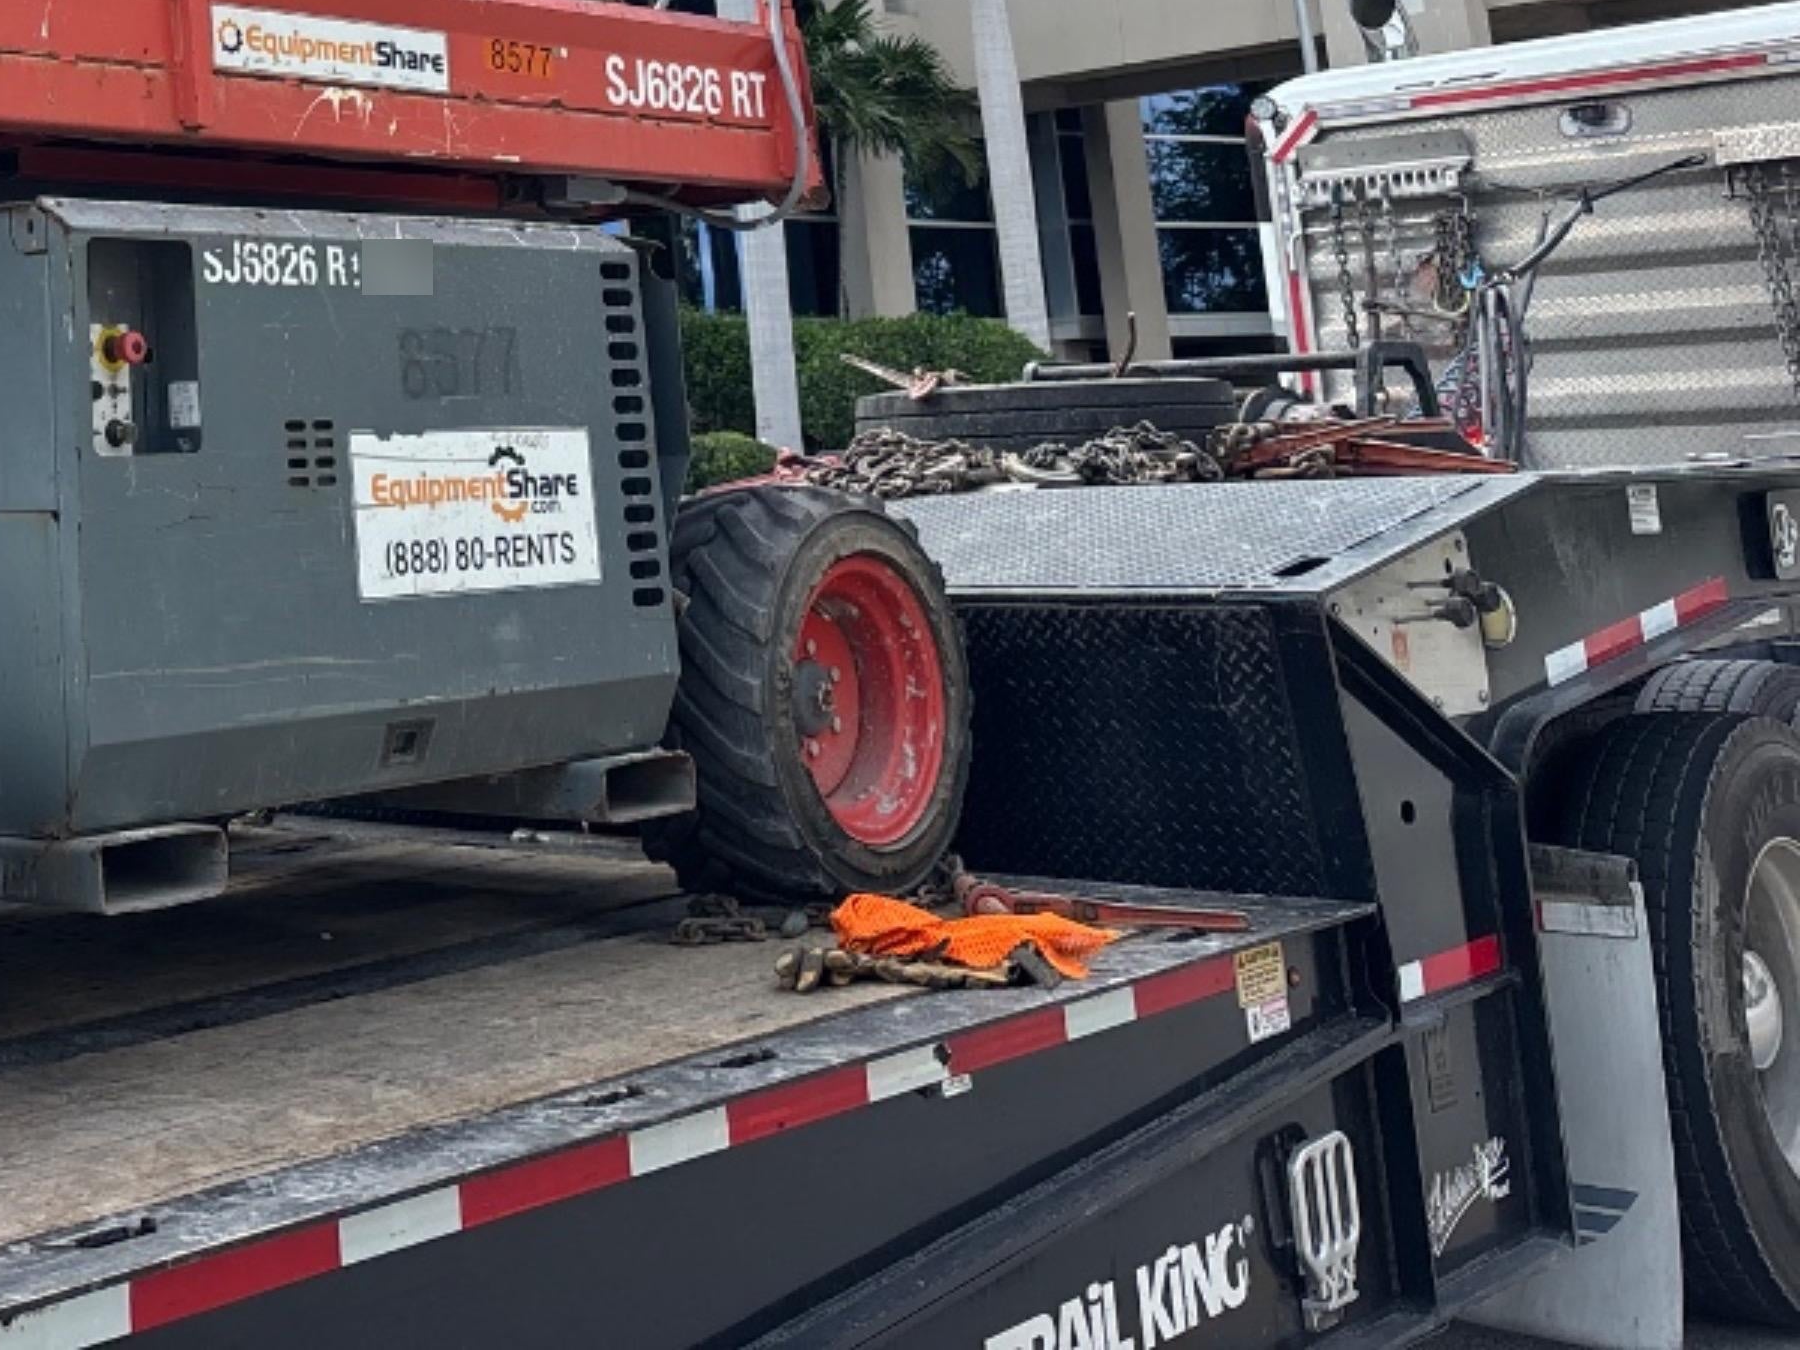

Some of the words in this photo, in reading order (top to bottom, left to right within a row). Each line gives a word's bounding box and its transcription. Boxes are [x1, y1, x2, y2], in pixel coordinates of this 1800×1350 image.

[245, 24, 445, 74] EquipmentShare
[490, 38, 552, 78] 8577
[605, 54, 721, 115] SJ6826
[730, 70, 766, 118] RT
[371, 467, 579, 510] EquipmentShare
[386, 536, 450, 578] (888)
[455, 530, 577, 571] 80-RENTS
